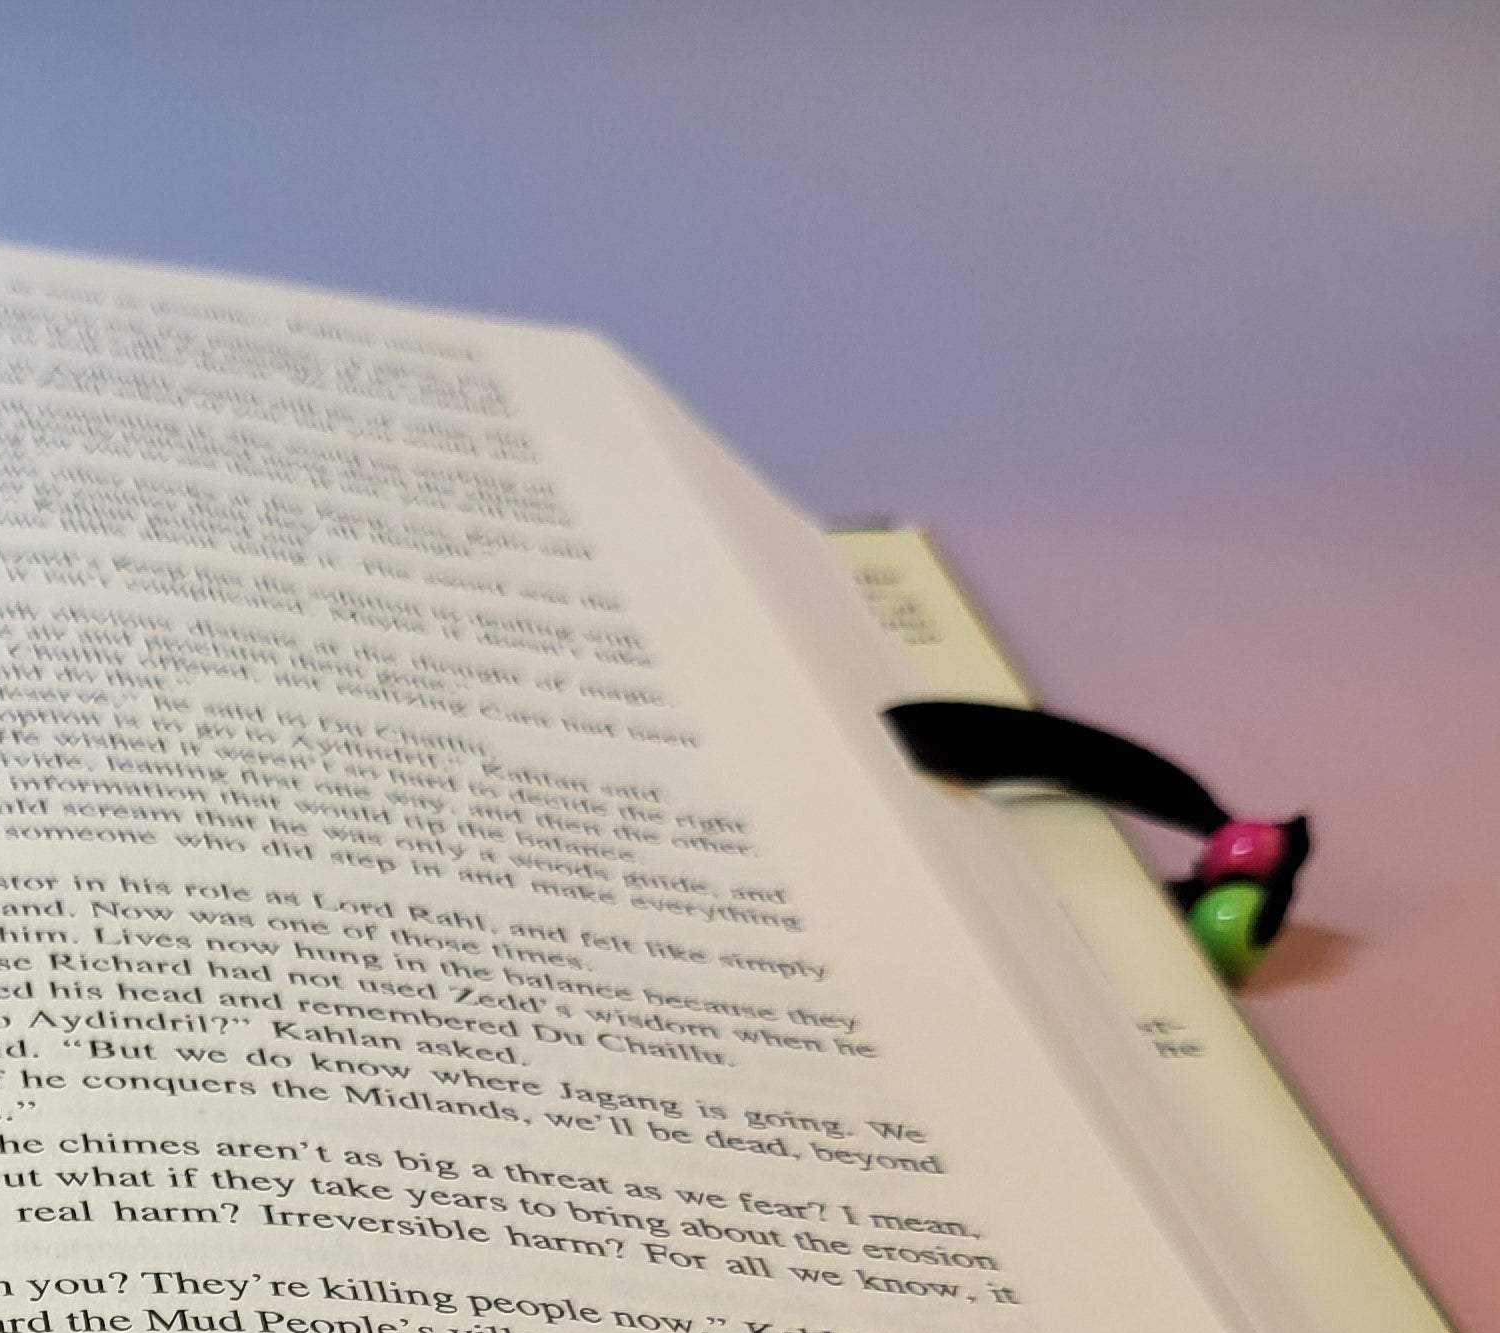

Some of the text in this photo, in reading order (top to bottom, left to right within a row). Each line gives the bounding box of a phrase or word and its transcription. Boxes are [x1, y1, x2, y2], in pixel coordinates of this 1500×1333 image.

[54, 1164, 156, 1188] what
[166, 1165, 200, 1189] if
[209, 1167, 296, 1199] they
[308, 1175, 394, 1201] take
[402, 1186, 510, 1213] years
[516, 1196, 558, 1219] to
[563, 1198, 672, 1239] bring
[678, 1216, 788, 1249] about
[792, 1229, 854, 1257] the
[860, 1242, 1001, 1272] erosion
[57, 1131, 202, 1156] chimes
[214, 1140, 332, 1164] aren’t
[342, 1149, 384, 1168] as
[392, 1148, 460, 1181] big
[470, 1162, 495, 1180] a
[502, 1161, 614, 1196] threat
[622, 1181, 664, 1202] as
[672, 1188, 730, 1210] we
[737, 1190, 828, 1223] fear?
[837, 1203, 861, 1227] I
[867, 1212, 982, 1242] mean,
[15, 1198, 94, 1224] real
[112, 1198, 240, 1225] harm?
[258, 1202, 492, 1244] Irreversible
[502, 1223, 626, 1260] harm?
[640, 1241, 708, 1271] For
[724, 1254, 776, 1280] all
[786, 1265, 846, 1288] we
[852, 1267, 978, 1305] know,
[984, 1280, 1022, 1306] it
[24, 1270, 129, 1303] you?
[138, 1269, 311, 1302] They’re
[316, 1275, 459, 1315] killing
[464, 1293, 604, 1326] people
[64, 1307, 134, 1333] the
[141, 1307, 247, 1333] Mud
